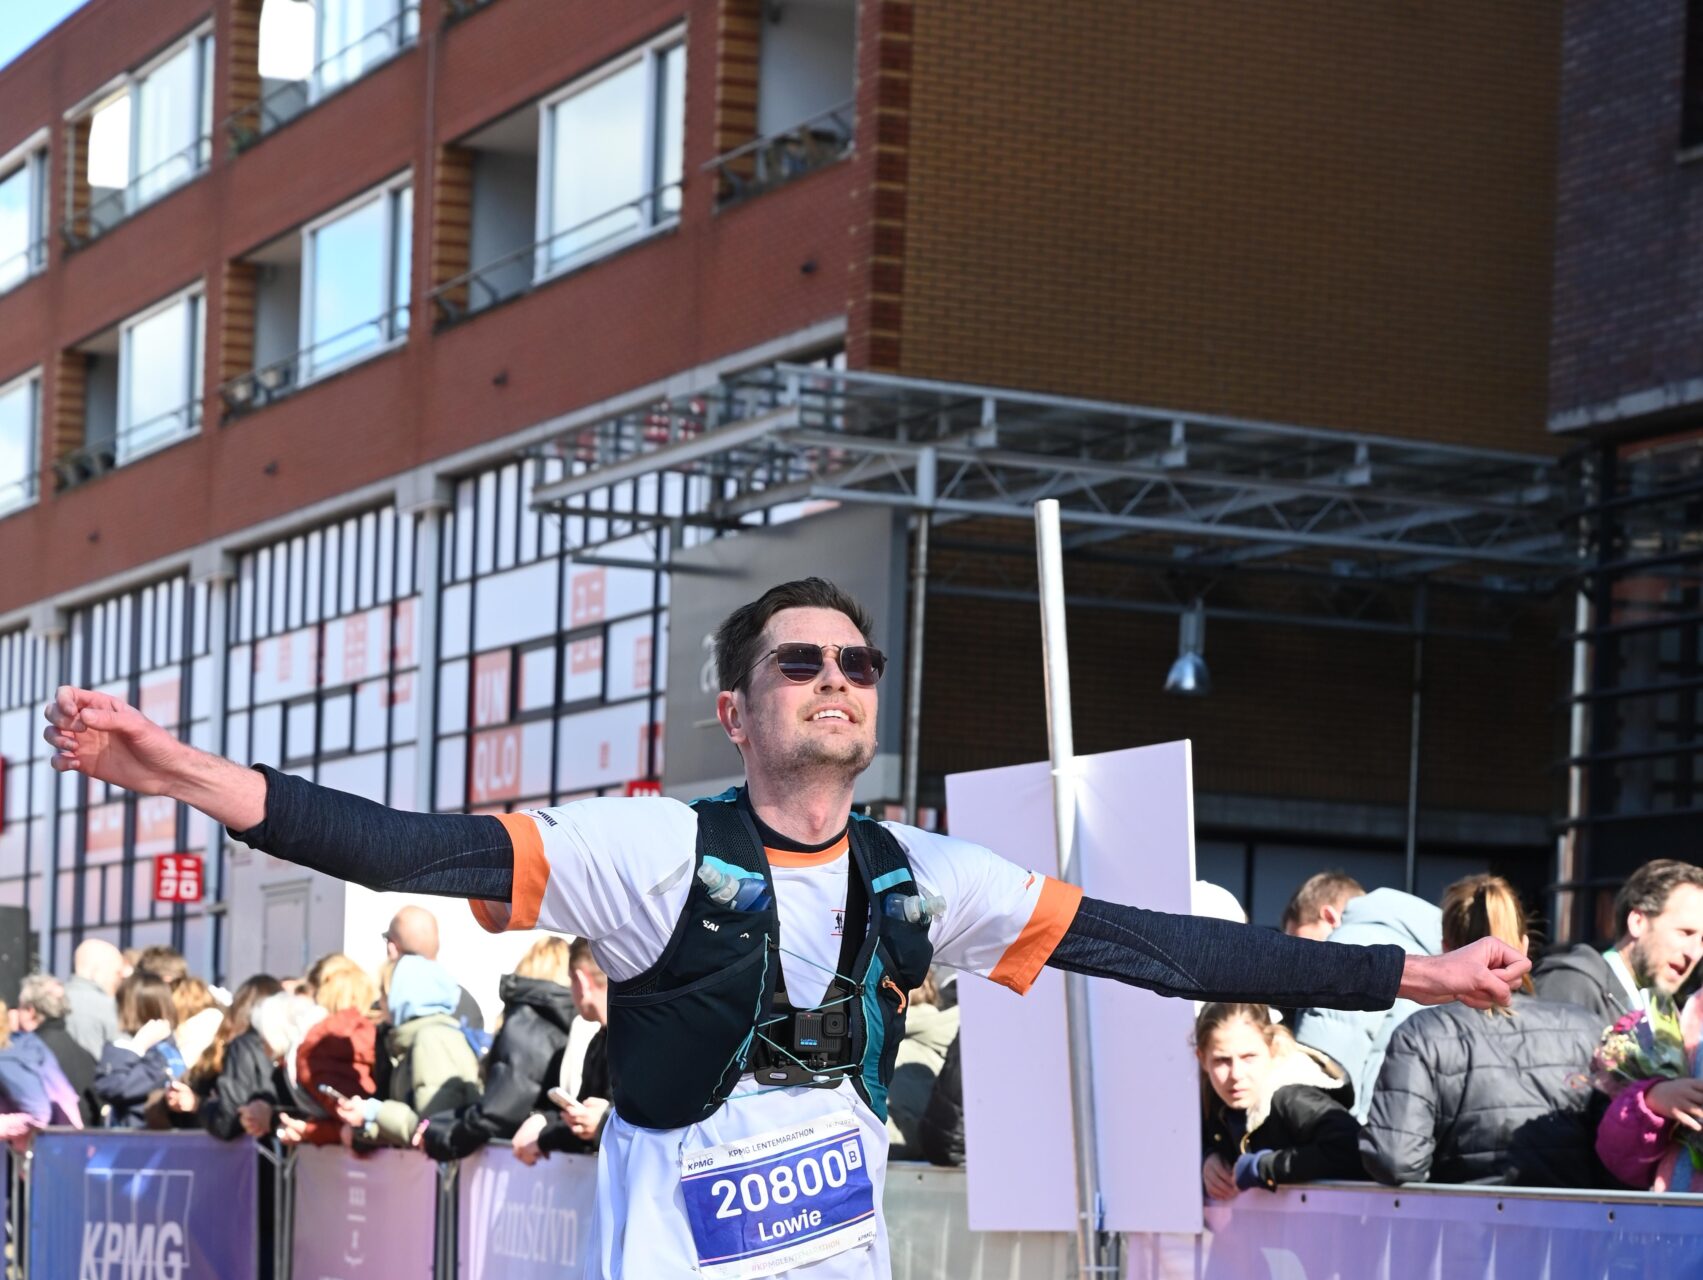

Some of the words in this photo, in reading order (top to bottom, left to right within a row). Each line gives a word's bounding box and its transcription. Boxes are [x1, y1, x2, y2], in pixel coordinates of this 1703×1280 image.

[728, 1147, 751, 1159] KPMG
[752, 1127, 815, 1153] LENTEMARATHON
[848, 1150, 858, 1164] B
[687, 1157, 714, 1171] KPMG
[711, 1149, 848, 1219] 20800
[757, 1208, 823, 1242] Lowie
